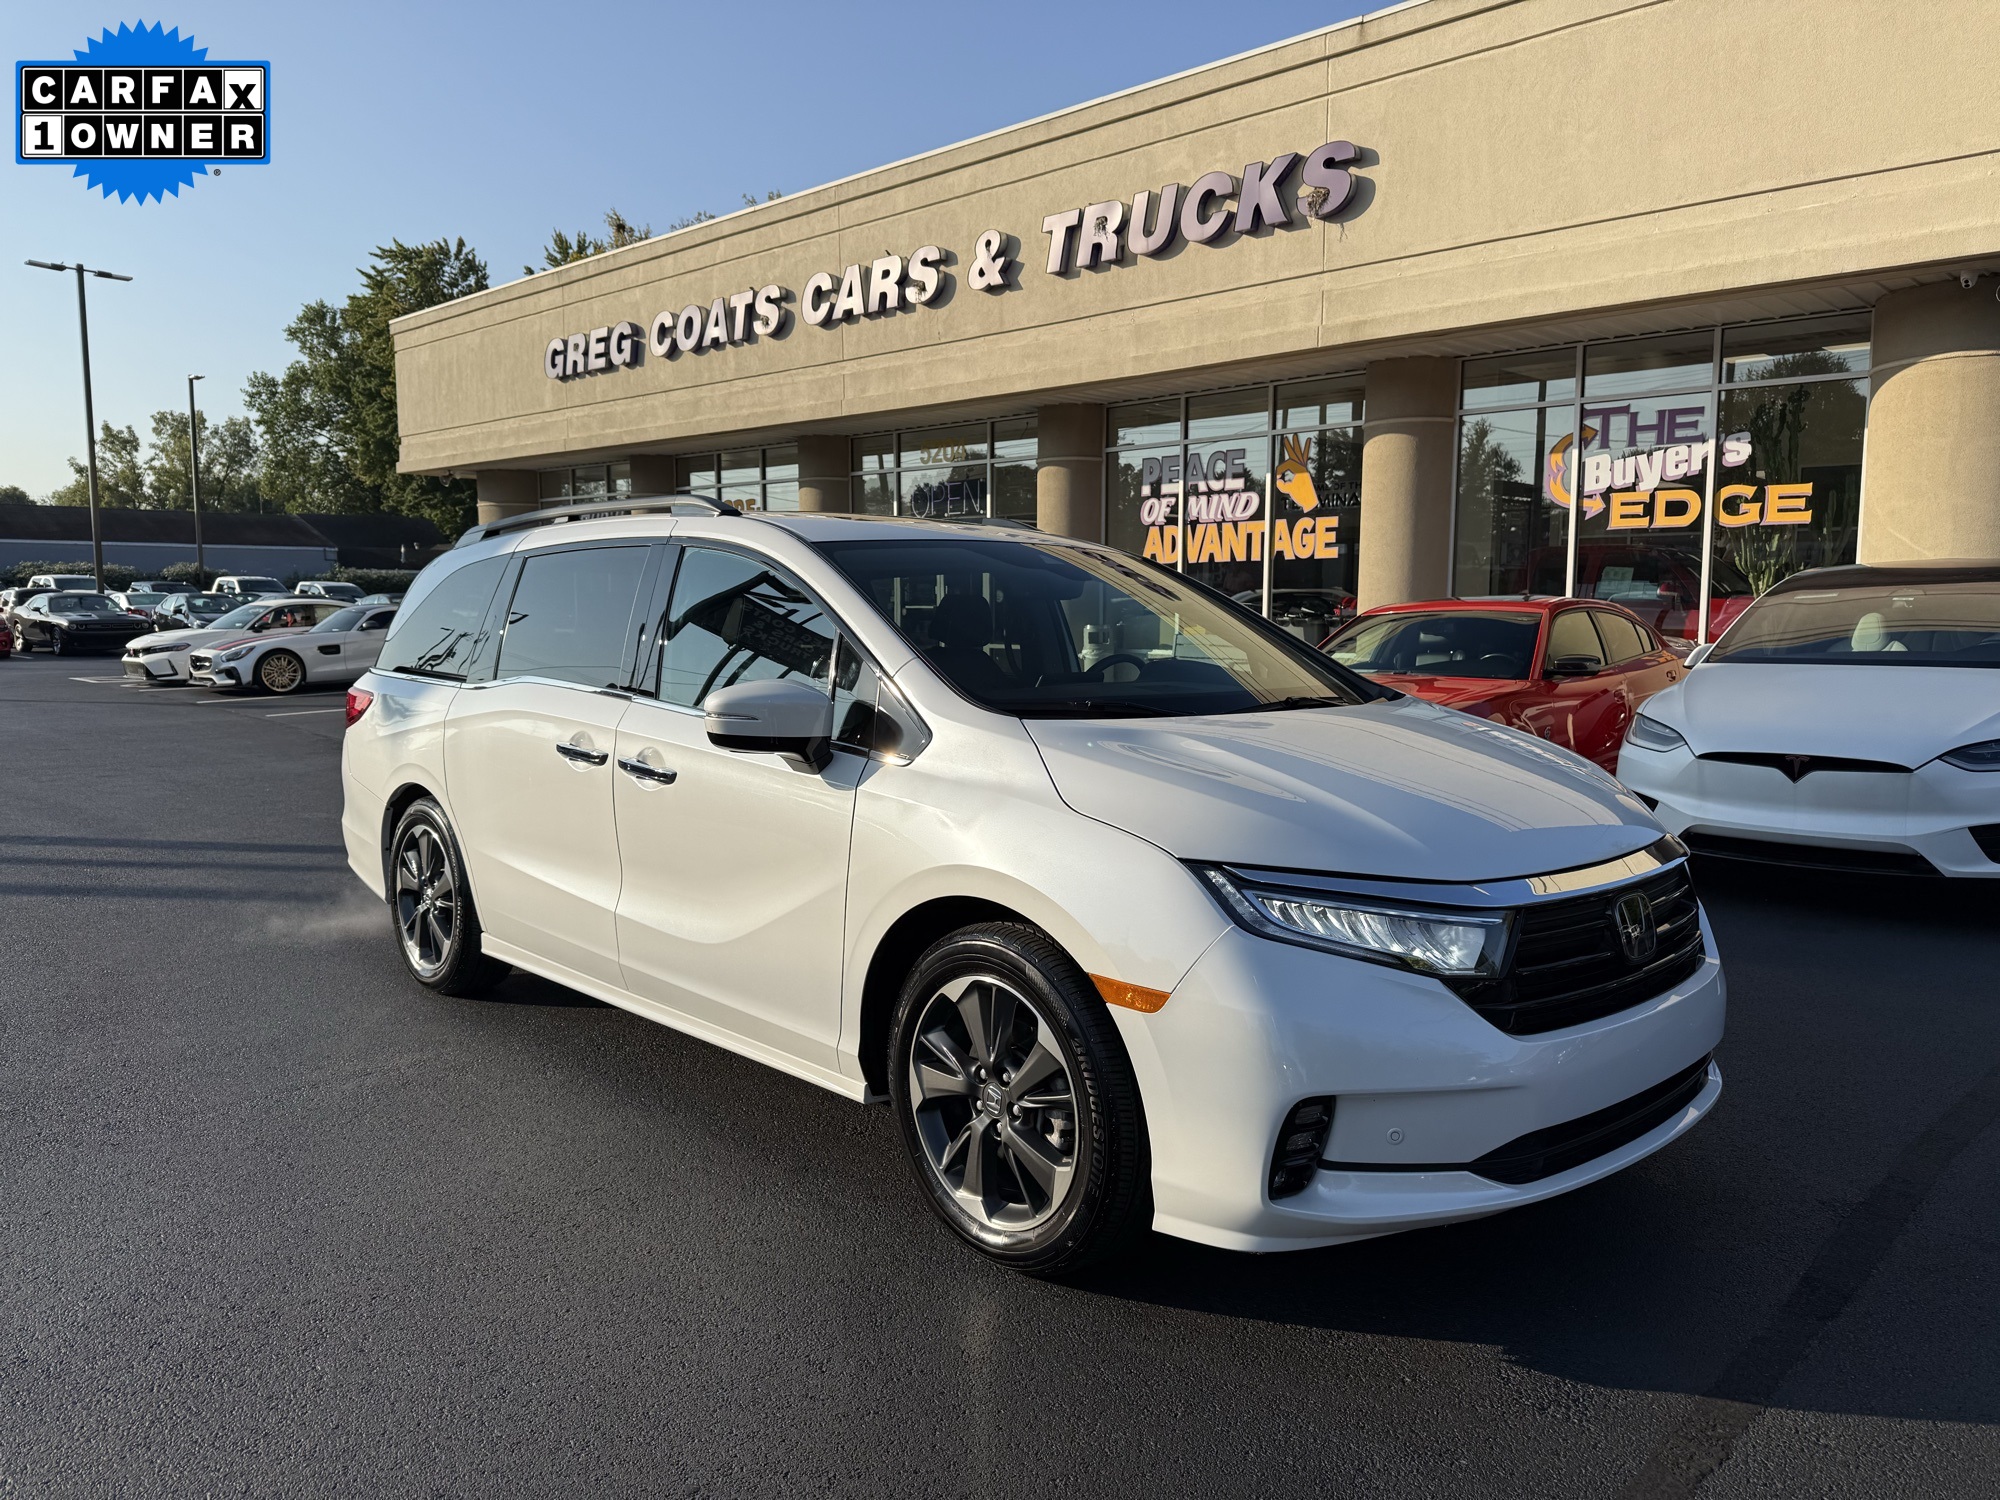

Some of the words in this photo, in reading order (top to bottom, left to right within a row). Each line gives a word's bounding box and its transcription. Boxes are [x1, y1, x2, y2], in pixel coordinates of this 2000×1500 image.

[544, 321, 639, 380] GREG
[649, 284, 787, 357] COATS
[802, 245, 947, 326] CARS
[967, 229, 1008, 291] &
[1041, 140, 1362, 275] TRUCKS
[1583, 403, 1705, 450] THE
[920, 438, 967, 465] 5204
[1141, 449, 1246, 497] PEACE
[911, 480, 981, 519] OPEN
[1141, 497, 1176, 525] OF
[1186, 491, 1259, 523] MIND
[1606, 482, 1813, 530] EDGE
[1142, 516, 1339, 564] ADVANTAGE
